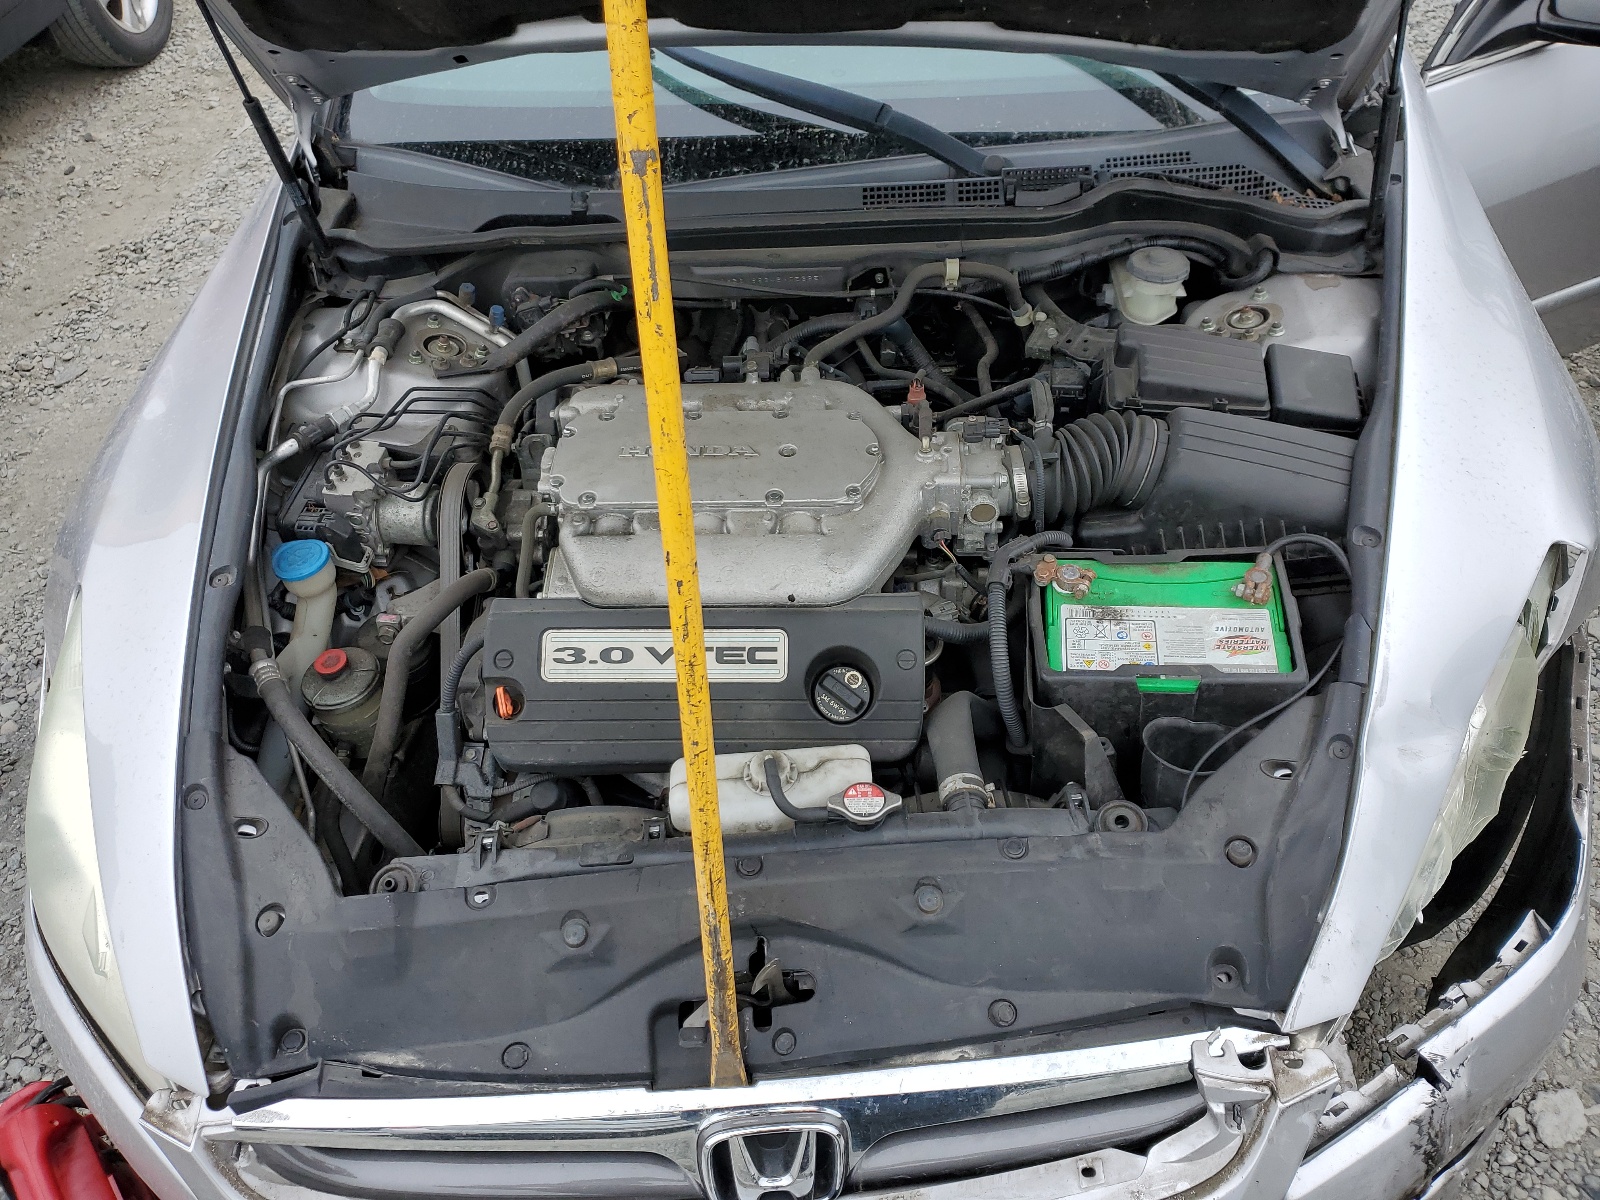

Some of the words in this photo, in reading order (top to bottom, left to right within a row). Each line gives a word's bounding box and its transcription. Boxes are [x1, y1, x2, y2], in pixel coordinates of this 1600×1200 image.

[618, 445, 760, 458] HNDA
[1213, 644, 1271, 652] INTERSTATE
[552, 646, 634, 665] 3.0
[644, 646, 778, 665] VEC
